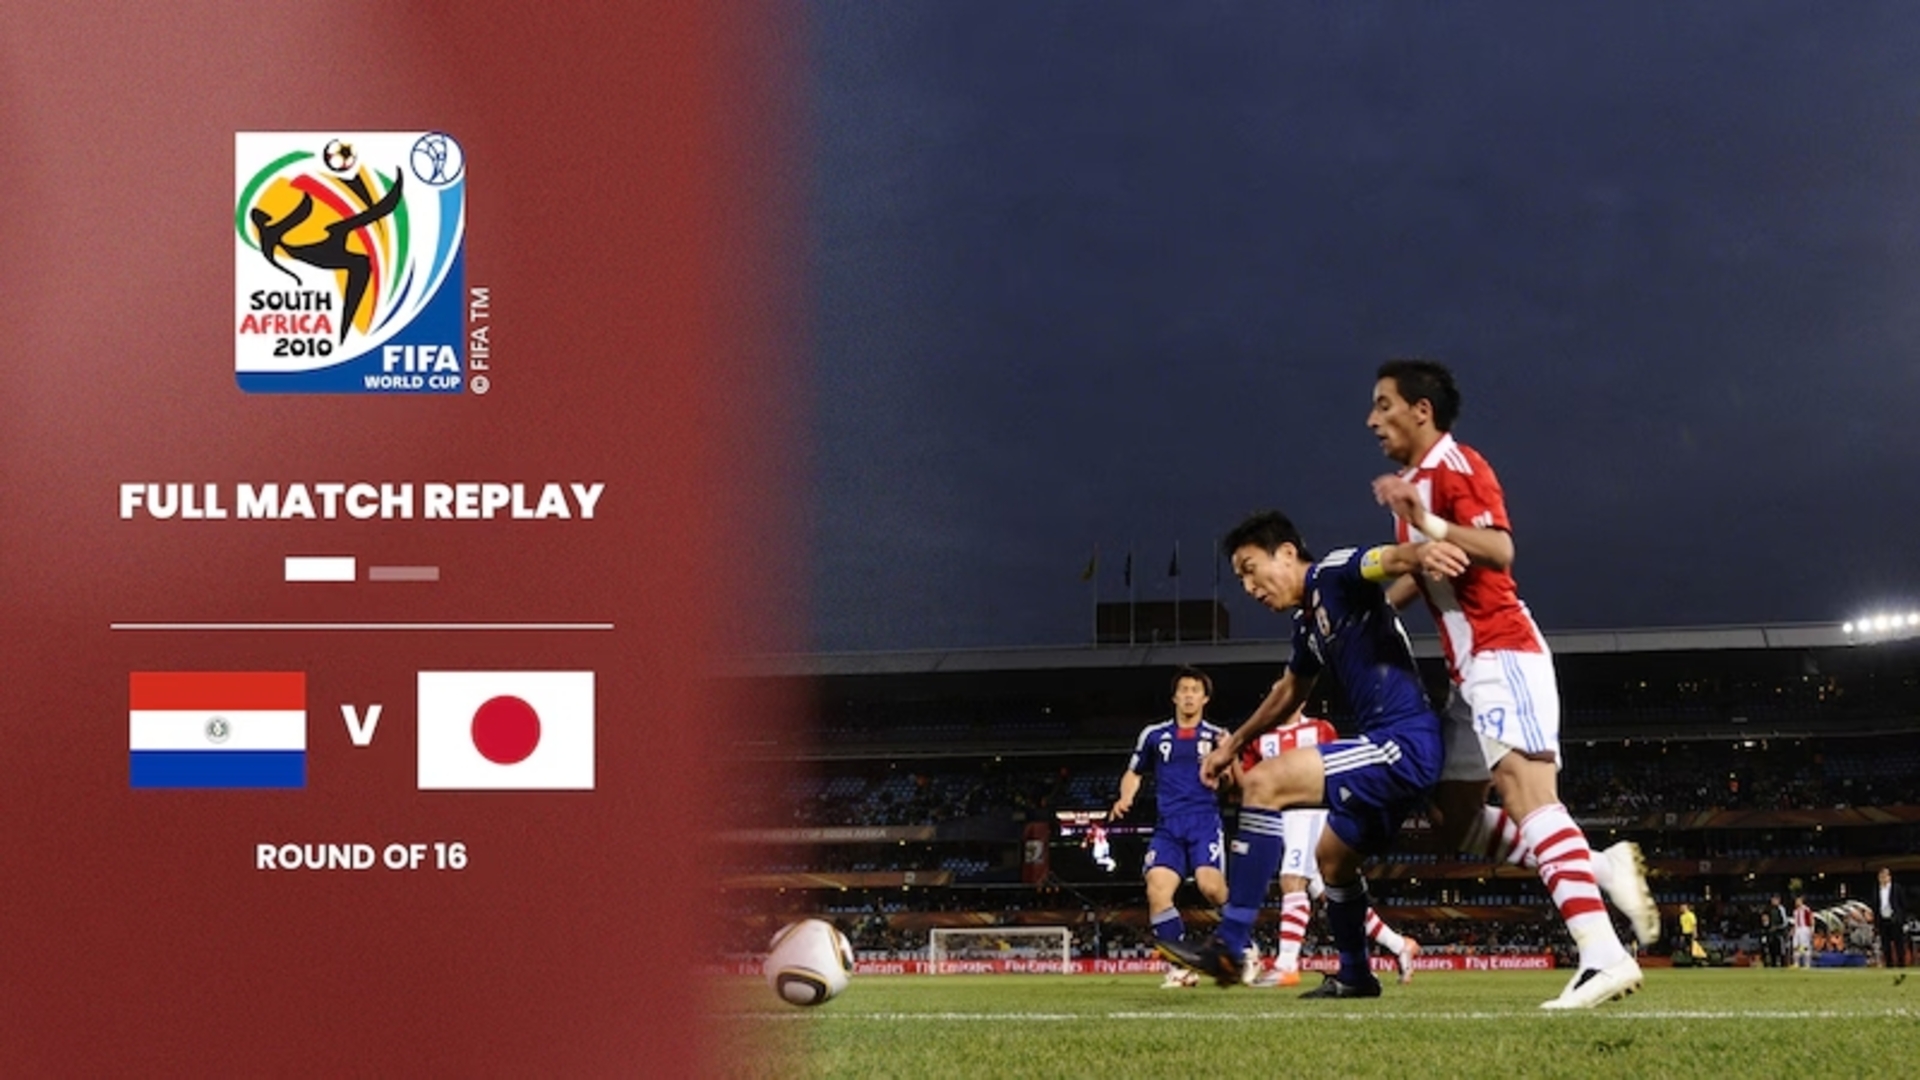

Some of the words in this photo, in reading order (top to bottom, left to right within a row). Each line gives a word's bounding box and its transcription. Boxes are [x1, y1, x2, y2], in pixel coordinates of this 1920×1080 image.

[1159, 742, 1172, 762] 9
[1265, 741, 1276, 758] 3
[1209, 842, 1221, 861] 9
[1289, 849, 1301, 867] 3
[1028, 960, 1083, 973] Emiraes
[1094, 959, 1117, 973] Fly
[1302, 957, 1340, 970] Emira
[1370, 957, 1395, 971] Fly
[1465, 956, 1488, 970] Fly
[1490, 956, 1549, 969] Emirates
